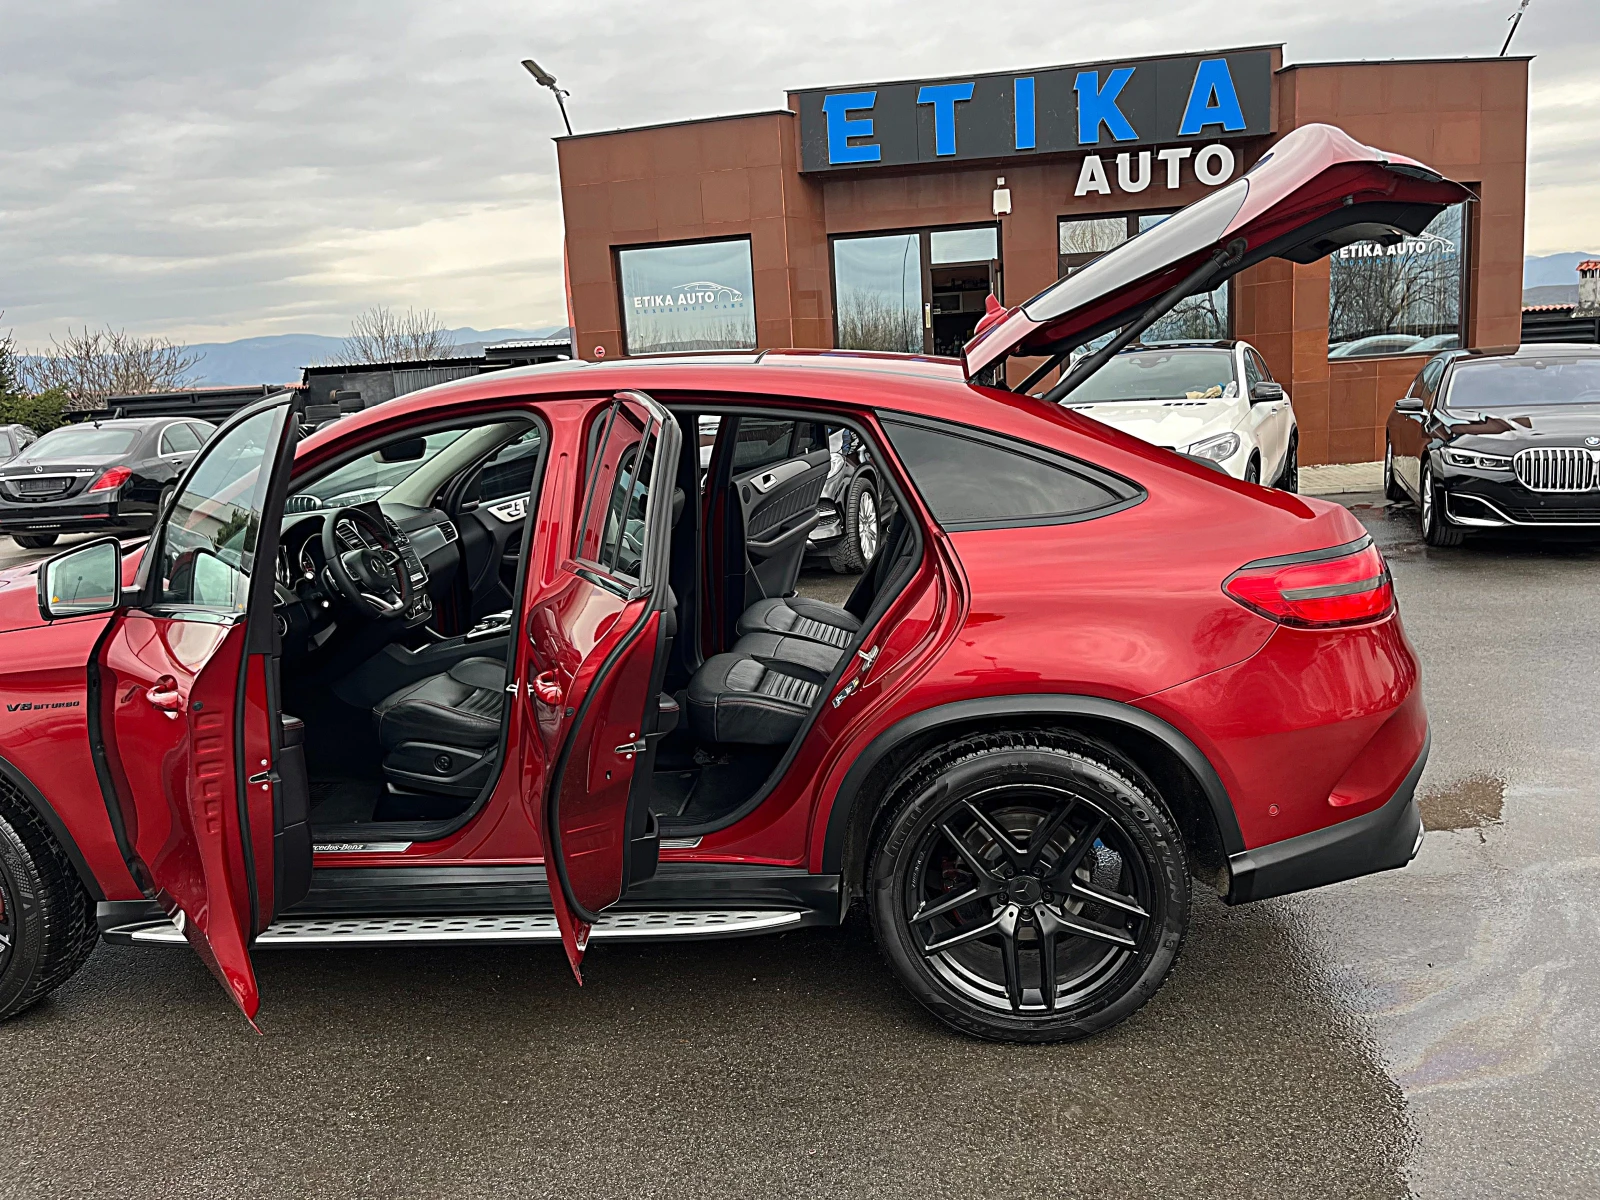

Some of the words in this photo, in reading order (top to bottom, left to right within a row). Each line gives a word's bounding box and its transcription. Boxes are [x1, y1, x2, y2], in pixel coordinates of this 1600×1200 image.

[822, 58, 1246, 165] ETIKA
[1073, 143, 1235, 197] AUTO
[1340, 243, 1382, 259] ETIKA
[1386, 241, 1426, 256] AUTO
[634, 294, 674, 308] ETIKA
[678, 291, 715, 305] AUTO
[636, 305, 705, 315] LUXURIOUS
[6, 702, 33, 712] V8
[33, 701, 80, 710] BITURBO
[1098, 780, 1182, 904] SCORPION
